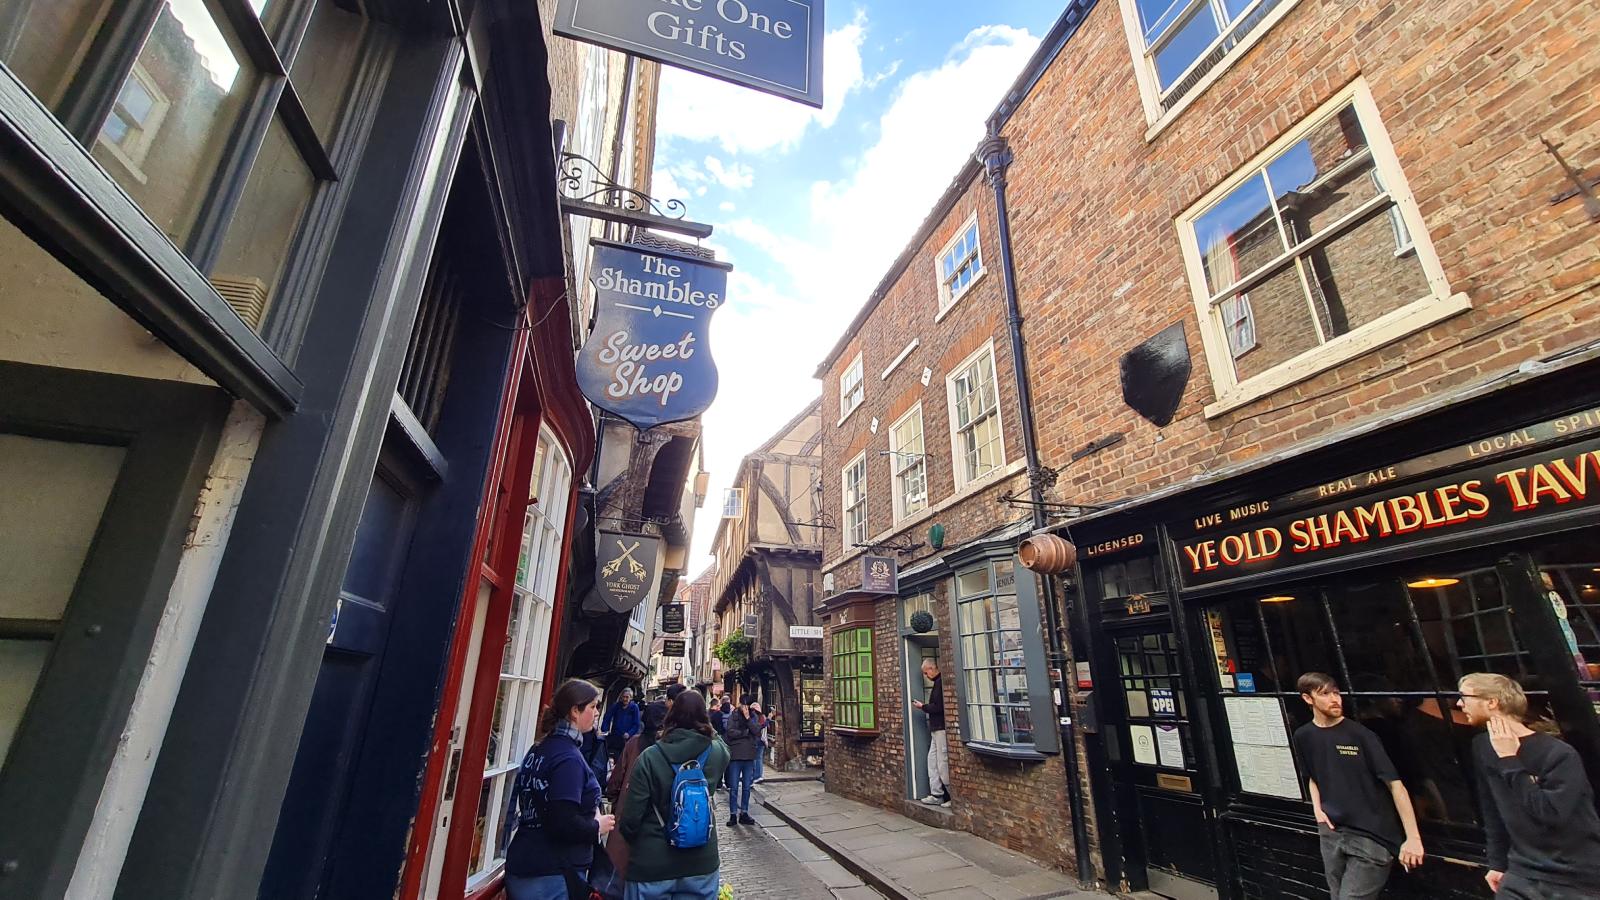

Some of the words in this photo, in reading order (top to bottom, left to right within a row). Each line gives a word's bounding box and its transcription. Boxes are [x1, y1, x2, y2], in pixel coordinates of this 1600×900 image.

[716, 0, 793, 39] One
[647, 11, 746, 61] Gifts
[640, 254, 681, 278] The
[596, 267, 720, 309] Shambles
[598, 330, 696, 364] Sweet
[608, 360, 683, 406] Shop
[1468, 429, 1536, 457] LOCAL
[1319, 478, 1357, 497] REAL
[1367, 466, 1397, 484] ALE
[1184, 540, 1219, 572] YE
[1219, 527, 1283, 566] OLD
[1289, 480, 1490, 552] SHAMBLES
[1195, 513, 1223, 530] LIVE
[1230, 501, 1270, 521] MUSIC
[1087, 533, 1144, 556] LICENSED
[621, 583, 640, 591] GHOST
